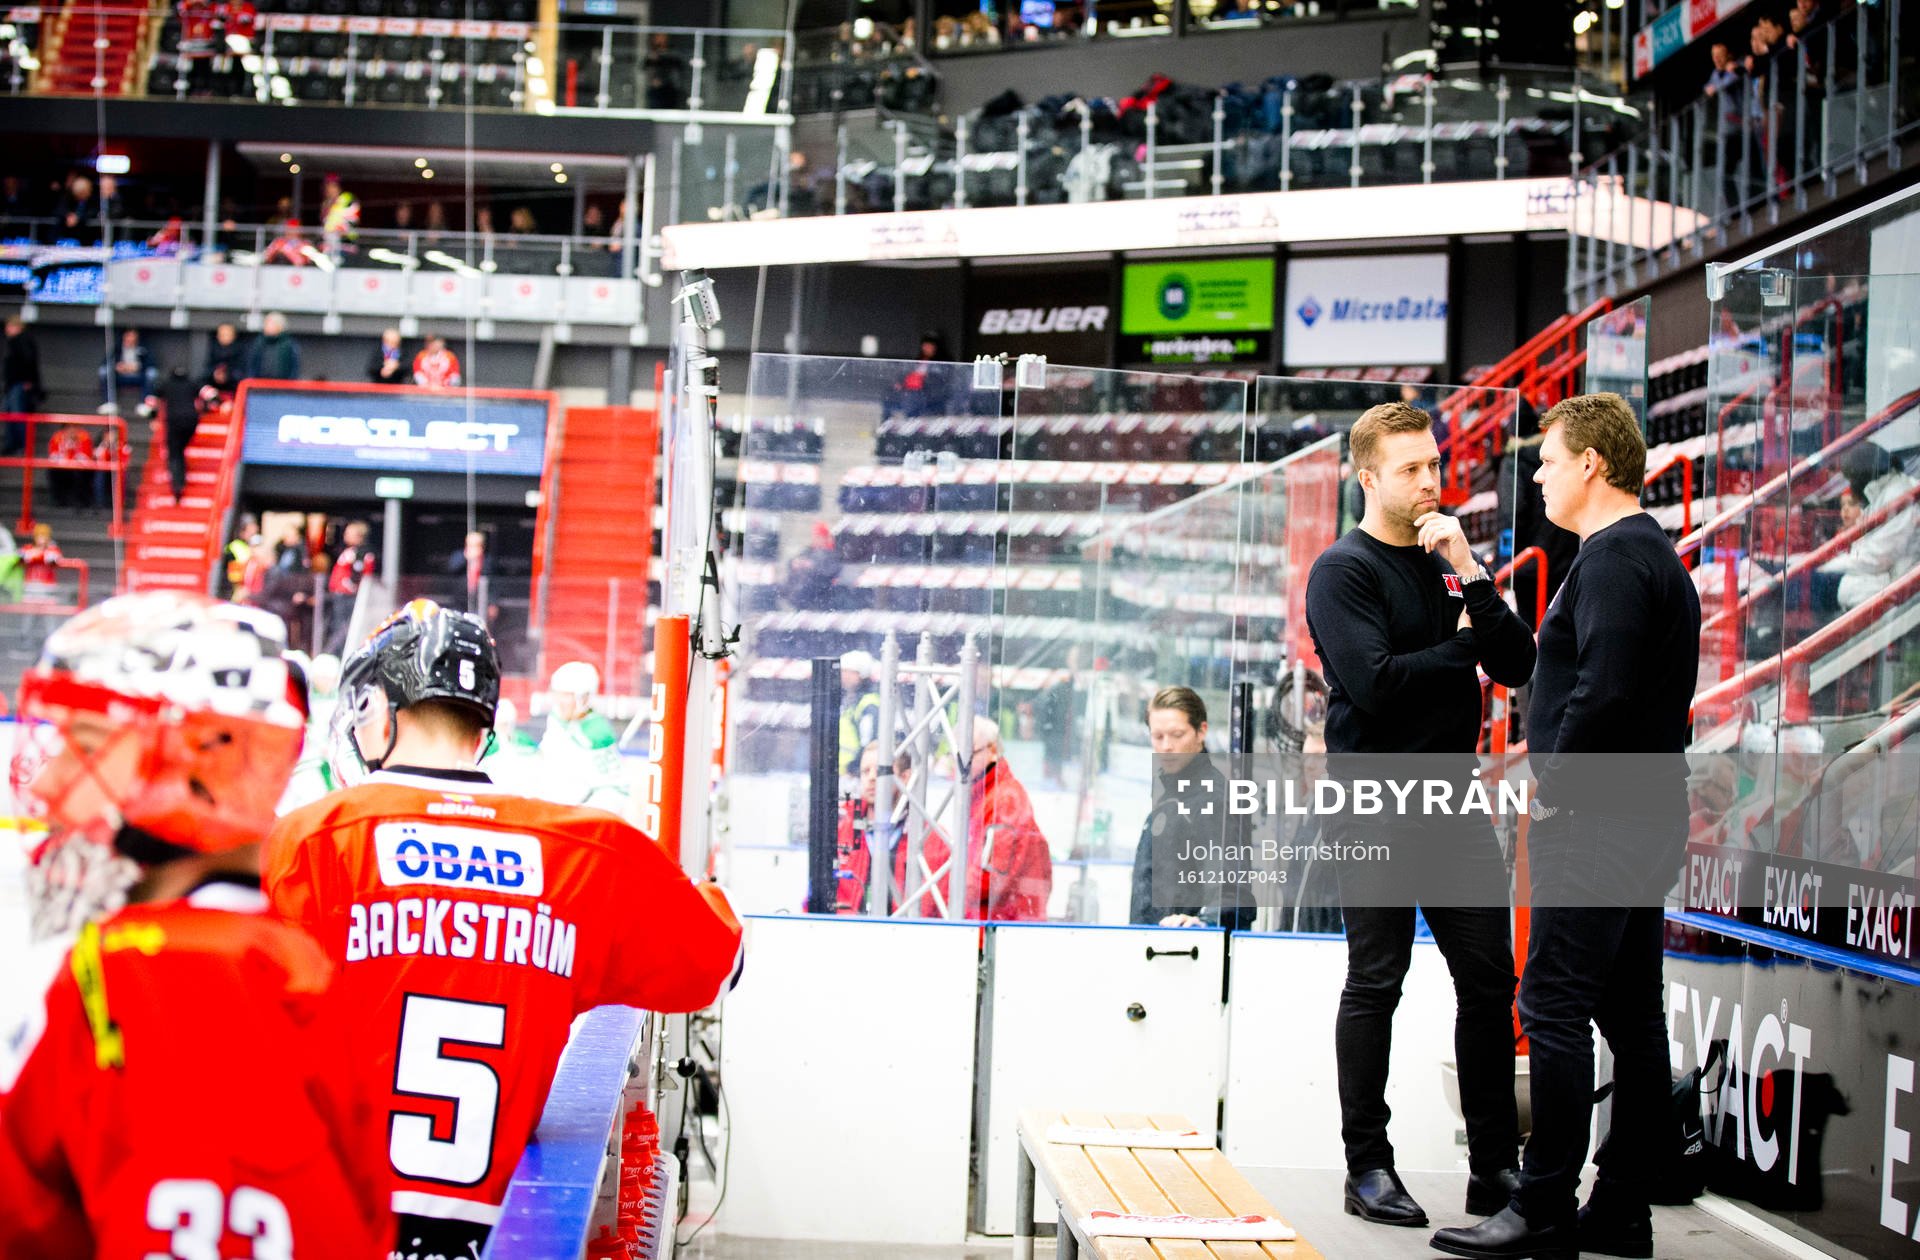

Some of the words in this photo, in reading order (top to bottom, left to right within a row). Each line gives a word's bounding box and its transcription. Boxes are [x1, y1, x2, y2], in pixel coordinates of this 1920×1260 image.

[396, 828, 525, 888] ÖBAB
[346, 898, 577, 979] BACKSTRÖM
[1689, 854, 1742, 917] EXACT
[1763, 866, 1823, 934] EXACT
[1846, 883, 1916, 959] EXACT
[388, 992, 507, 1187] 5
[1667, 980, 1812, 1185] EXACT
[144, 1178, 295, 1260] 33
